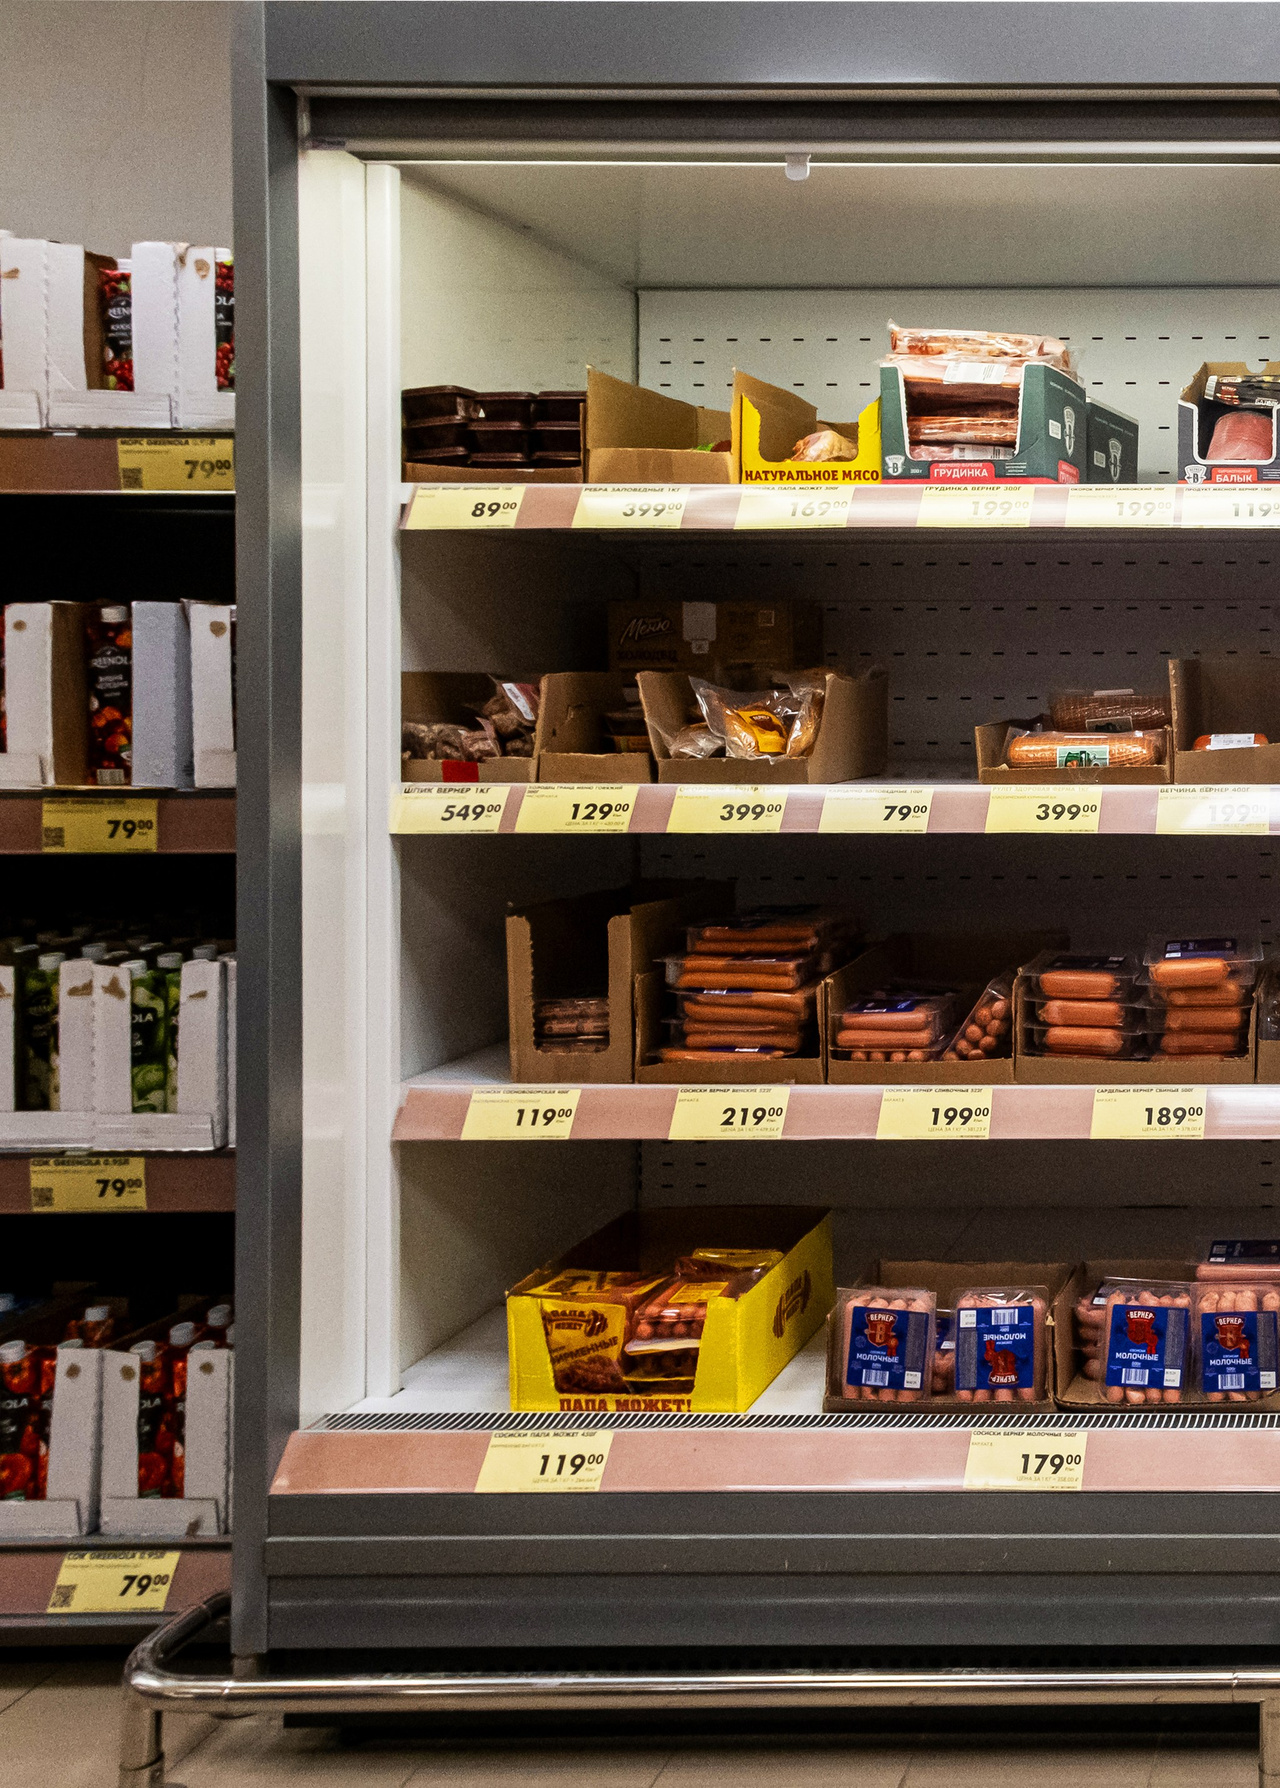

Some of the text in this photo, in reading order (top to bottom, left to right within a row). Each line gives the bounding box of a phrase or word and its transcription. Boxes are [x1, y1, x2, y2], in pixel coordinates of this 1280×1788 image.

[744, 470, 879, 481] НАТУРАЛЬНОЕ МЯСО
[934, 468, 988, 478] ГРУДИНКА
[1216, 474, 1253, 483] БАЛЫК
[870, 1313, 894, 1322] ВЕРНЕР
[1129, 1311, 1153, 1319] ВЕРНЕР
[1218, 1317, 1242, 1325] ВЕРНЕР
[856, 1353, 899, 1364] МОЛОЧНЫЕ
[1115, 1352, 1159, 1361] МОЛОЧНЫЕ
[1209, 1357, 1252, 1366] МОЛОЧНЫЕ
[559, 1399, 692, 1412] ПАПА МОЖЕТ!
